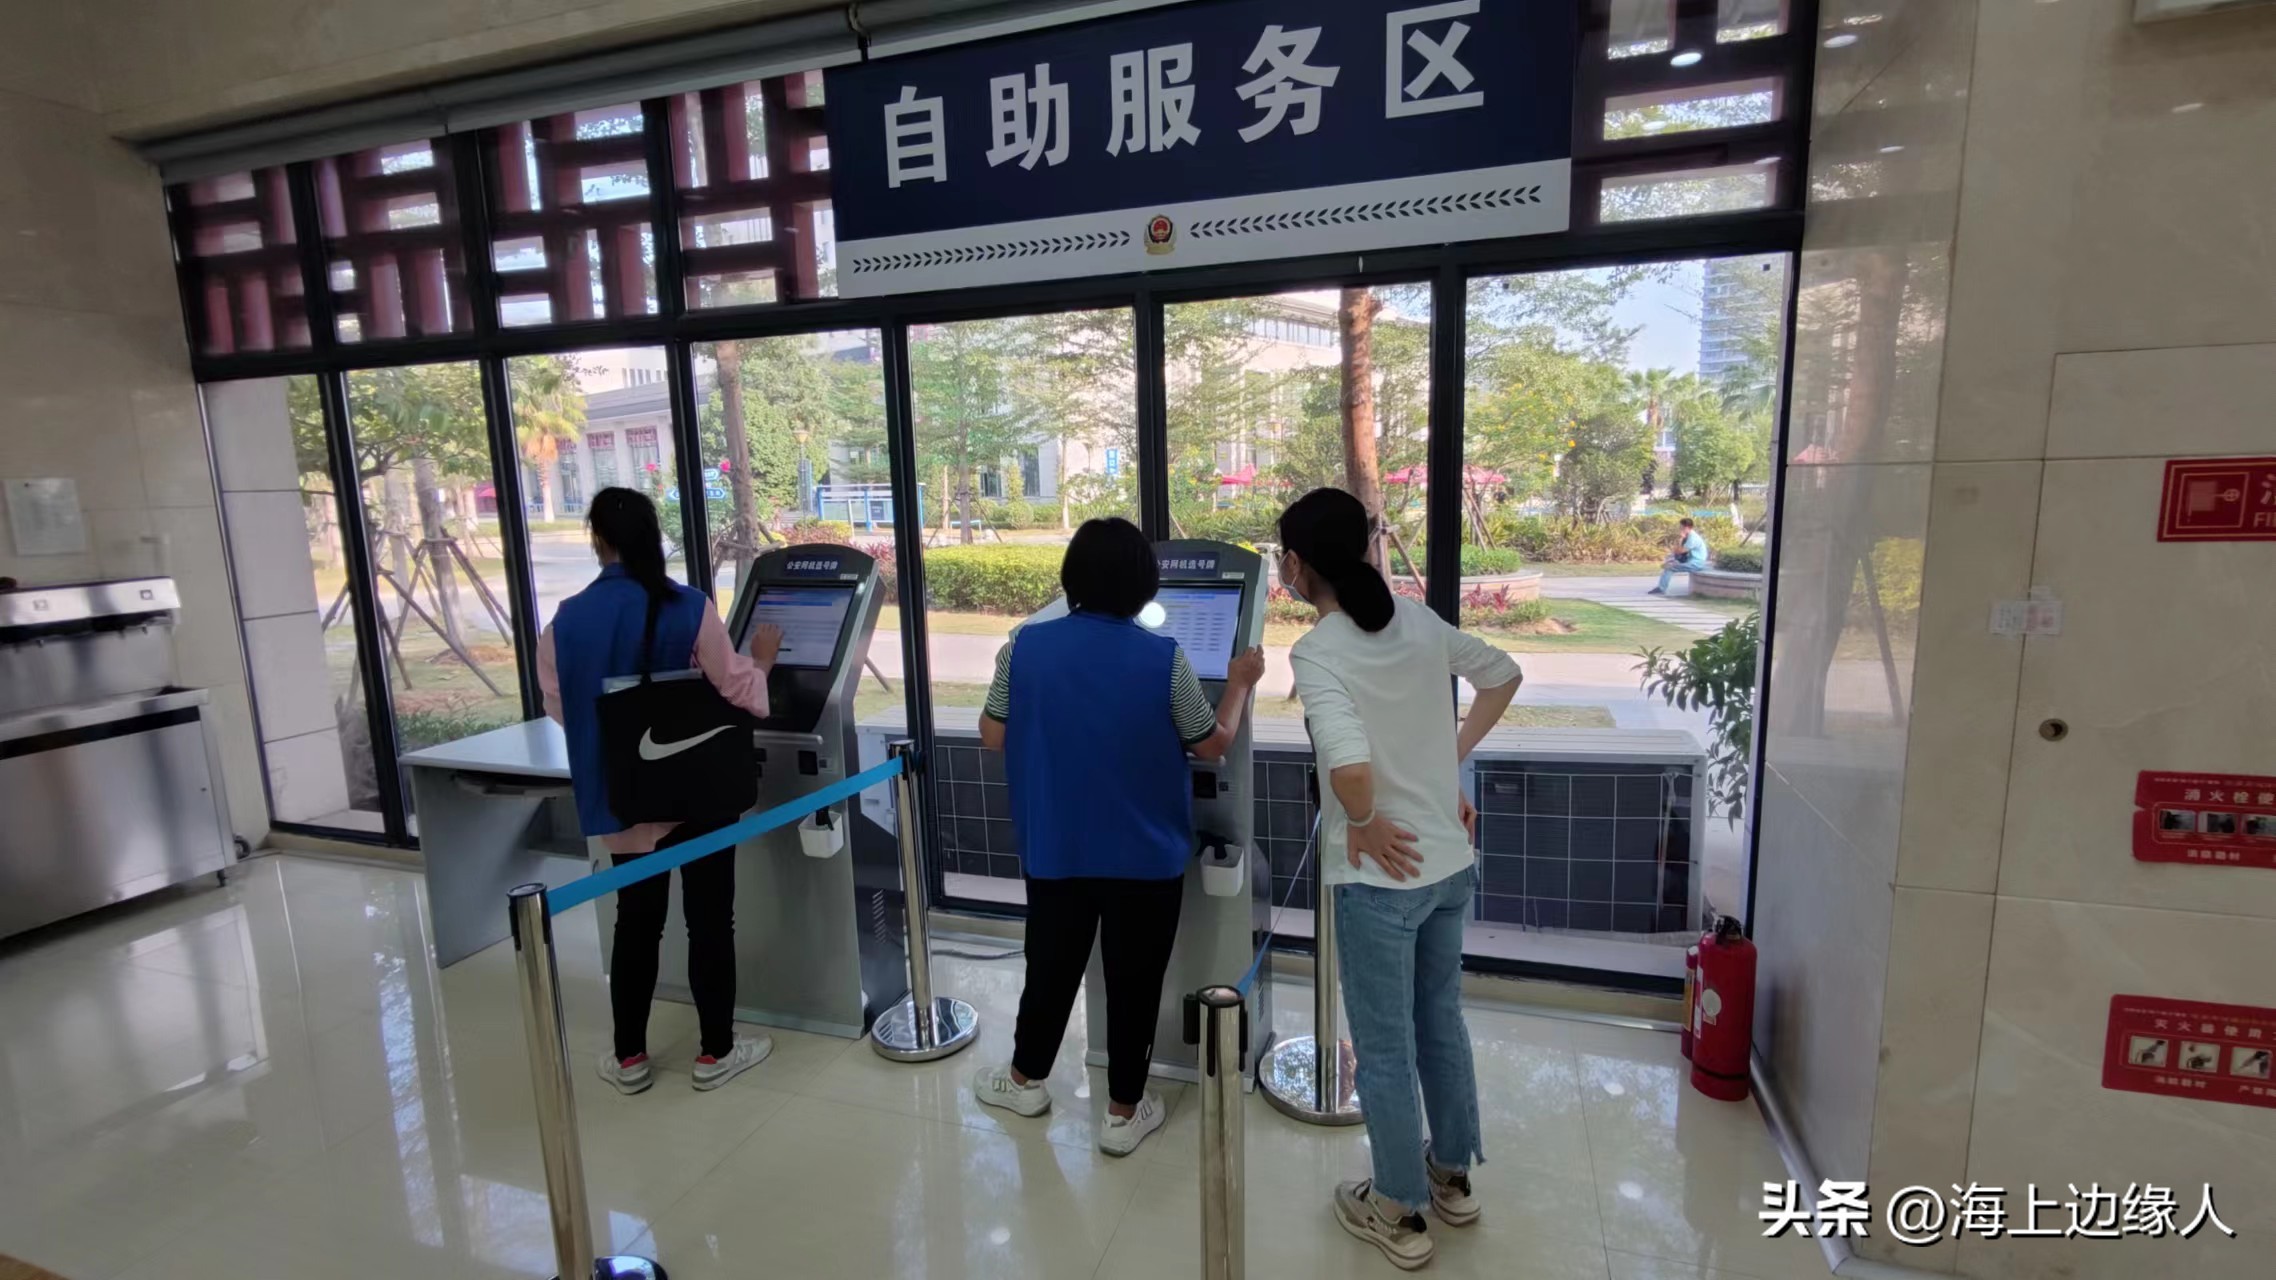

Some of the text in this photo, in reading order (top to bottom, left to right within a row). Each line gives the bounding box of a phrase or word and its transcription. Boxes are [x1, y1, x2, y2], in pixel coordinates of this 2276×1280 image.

[883, 0, 1485, 189] 自助服务区
[2154, 1018, 2276, 1041] 灭火器使用
